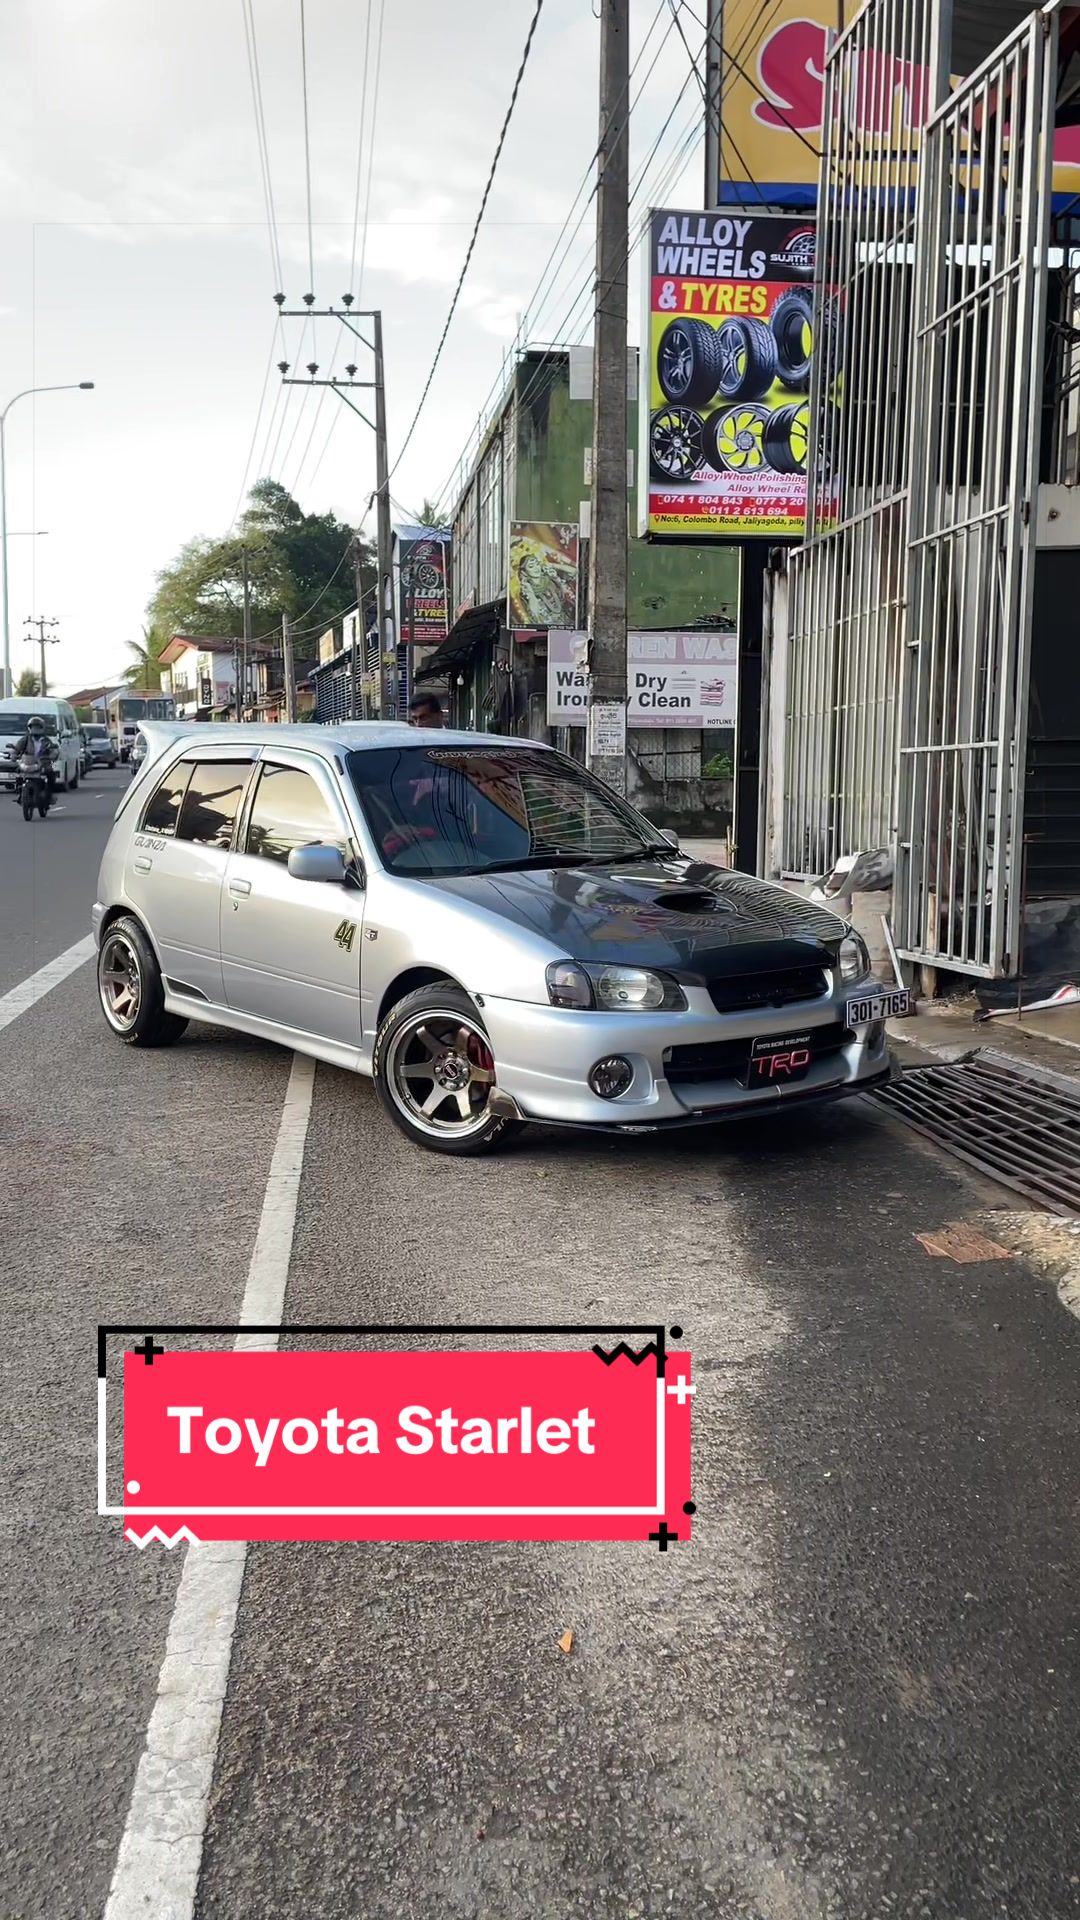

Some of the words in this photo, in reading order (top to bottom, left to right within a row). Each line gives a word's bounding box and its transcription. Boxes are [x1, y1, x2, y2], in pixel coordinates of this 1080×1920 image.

[658, 216, 753, 247] ALLOY
[657, 246, 766, 279] WHEELS
[770, 253, 808, 263] SUJITH
[658, 280, 678, 310] &
[681, 282, 768, 314] TYRES
[692, 471, 720, 481] Alloy
[723, 472, 757, 481] Wheel
[760, 473, 807, 485] Polishing
[727, 484, 755, 494] Alloy
[758, 485, 790, 493] Wheel
[663, 495, 685, 504] 074
[688, 496, 695, 504] 1
[697, 496, 719, 504] 804
[722, 497, 743, 505] 843
[755, 497, 777, 506] 077
[779, 497, 787, 506] 3
[709, 506, 730, 514] 011
[732, 507, 741, 515] 2
[743, 507, 764, 515] 613
[767, 507, 788, 515] 694
[682, 515, 718, 523] Colombo
[719, 516, 741, 525] Road,
[635, 672, 667, 692] Dry
[639, 692, 691, 707] Clean
[707, 718, 733, 726] HOTLINE
[333, 918, 357, 952] 44
